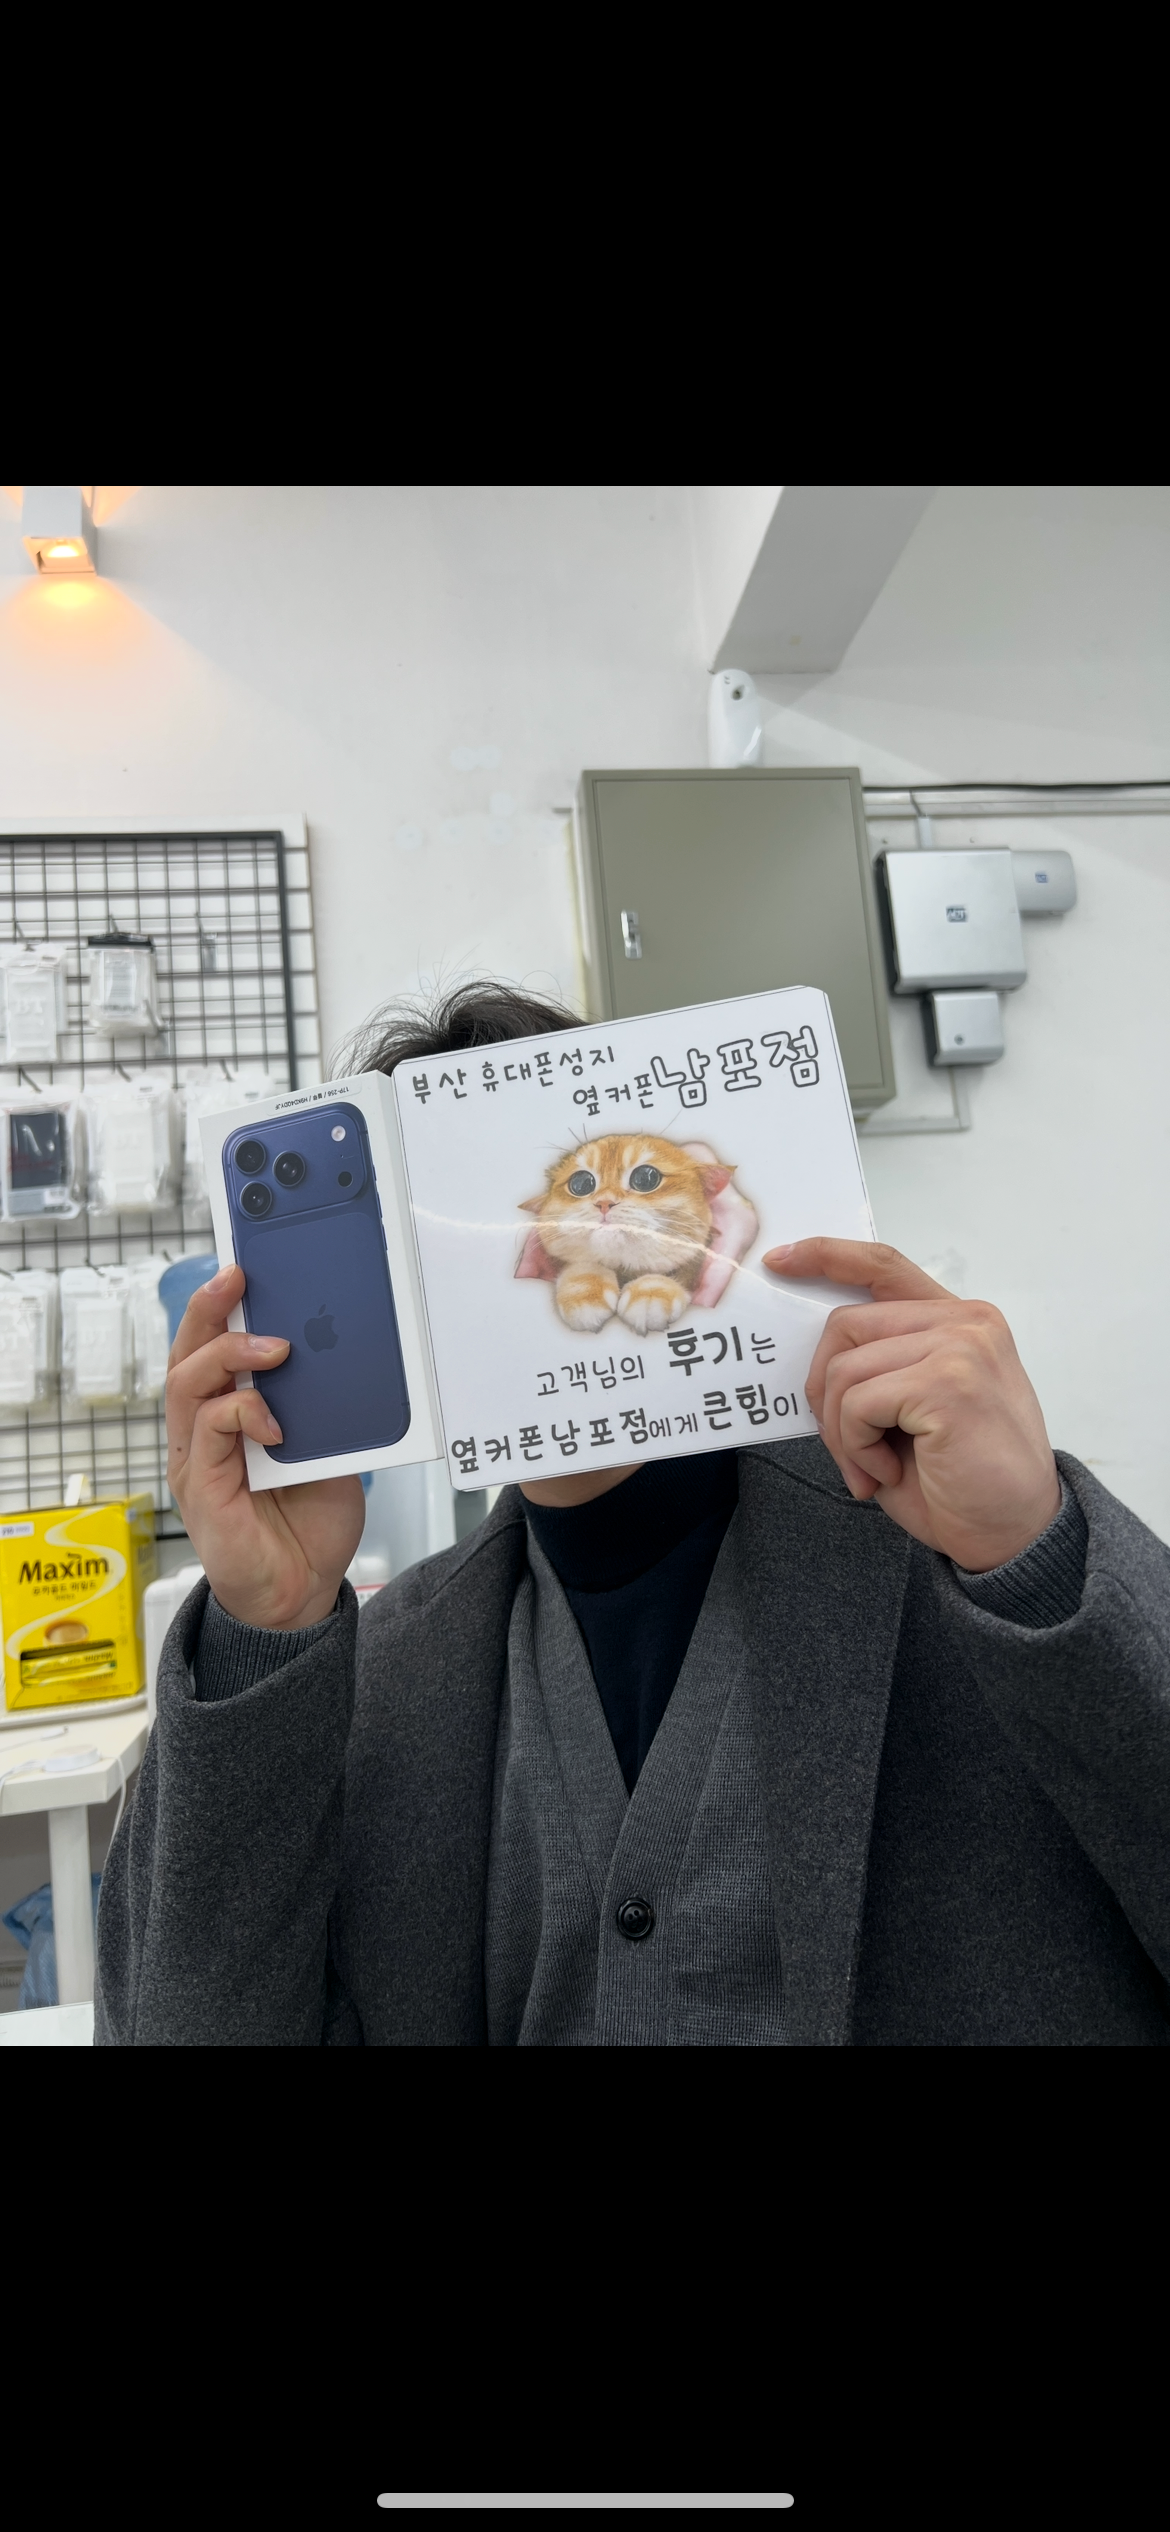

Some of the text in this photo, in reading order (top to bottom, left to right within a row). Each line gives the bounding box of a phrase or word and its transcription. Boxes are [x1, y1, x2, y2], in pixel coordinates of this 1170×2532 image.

[411, 1045, 615, 1105] 부산 휴대폰성지
[536, 1325, 777, 1398] 고객님의 후기는
[19, 1553, 110, 1584] Maxim
